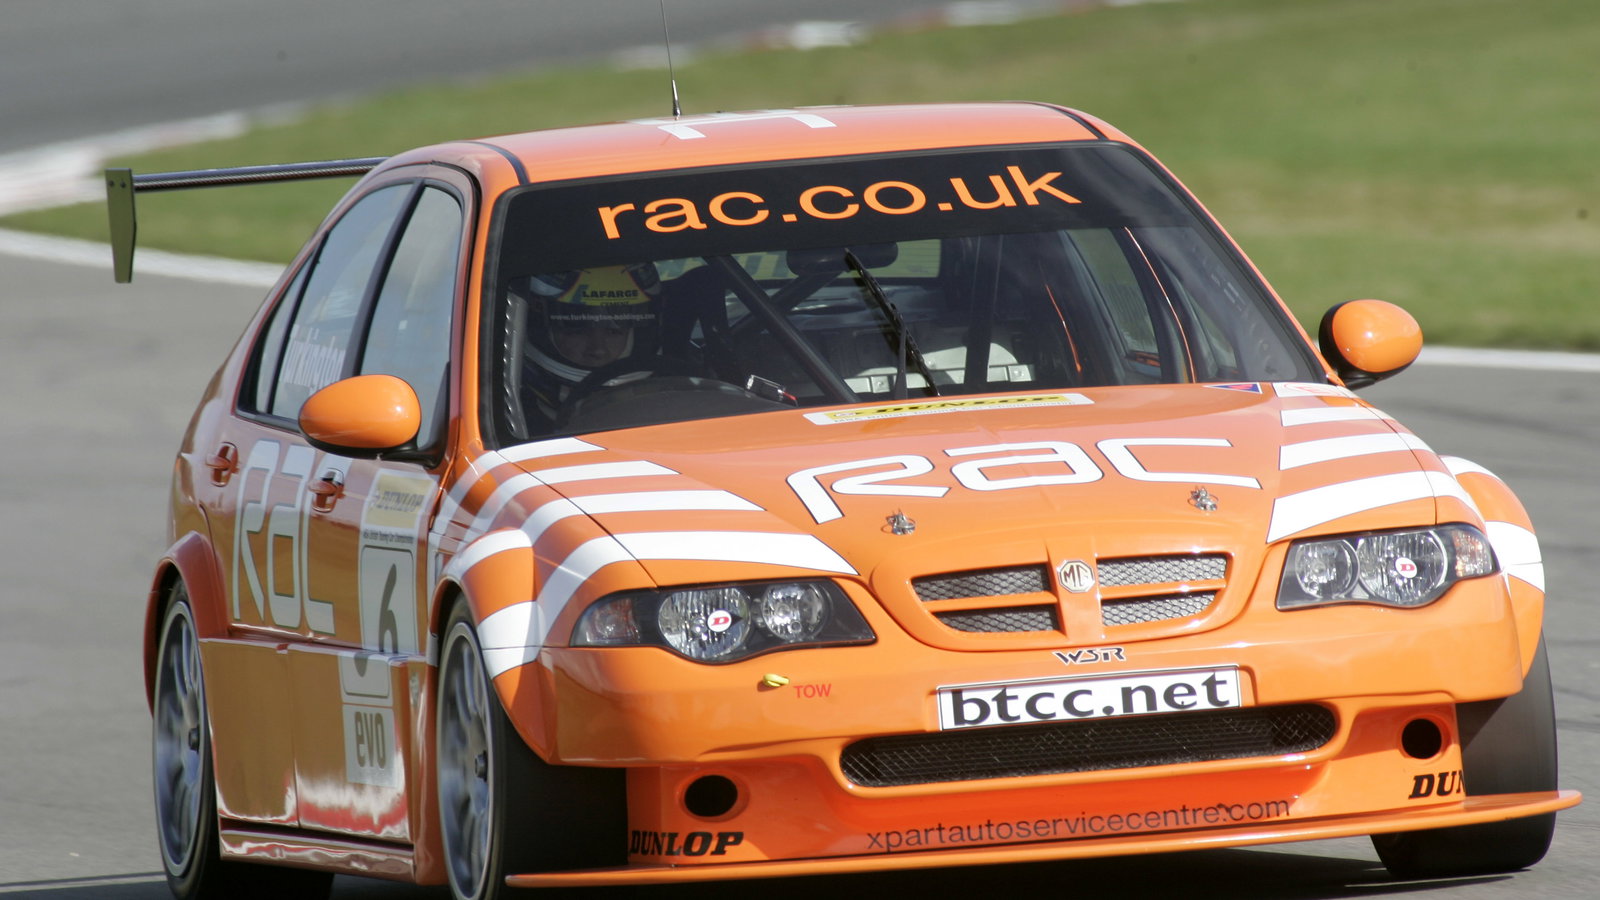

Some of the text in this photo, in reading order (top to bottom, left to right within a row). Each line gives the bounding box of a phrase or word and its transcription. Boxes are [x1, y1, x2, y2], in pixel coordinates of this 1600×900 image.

[598, 166, 1083, 240] rac.co.uk
[583, 290, 638, 298] LAFARGE
[1062, 563, 1090, 589] MG
[711, 616, 730, 626] D
[1054, 647, 1125, 664] WSR
[794, 684, 832, 698] TOW
[952, 671, 1231, 728] btcc.net
[355, 711, 386, 769] evo
[867, 799, 1290, 853] xpartautoservicecentre.com
[630, 830, 744, 856] DUNLOP
